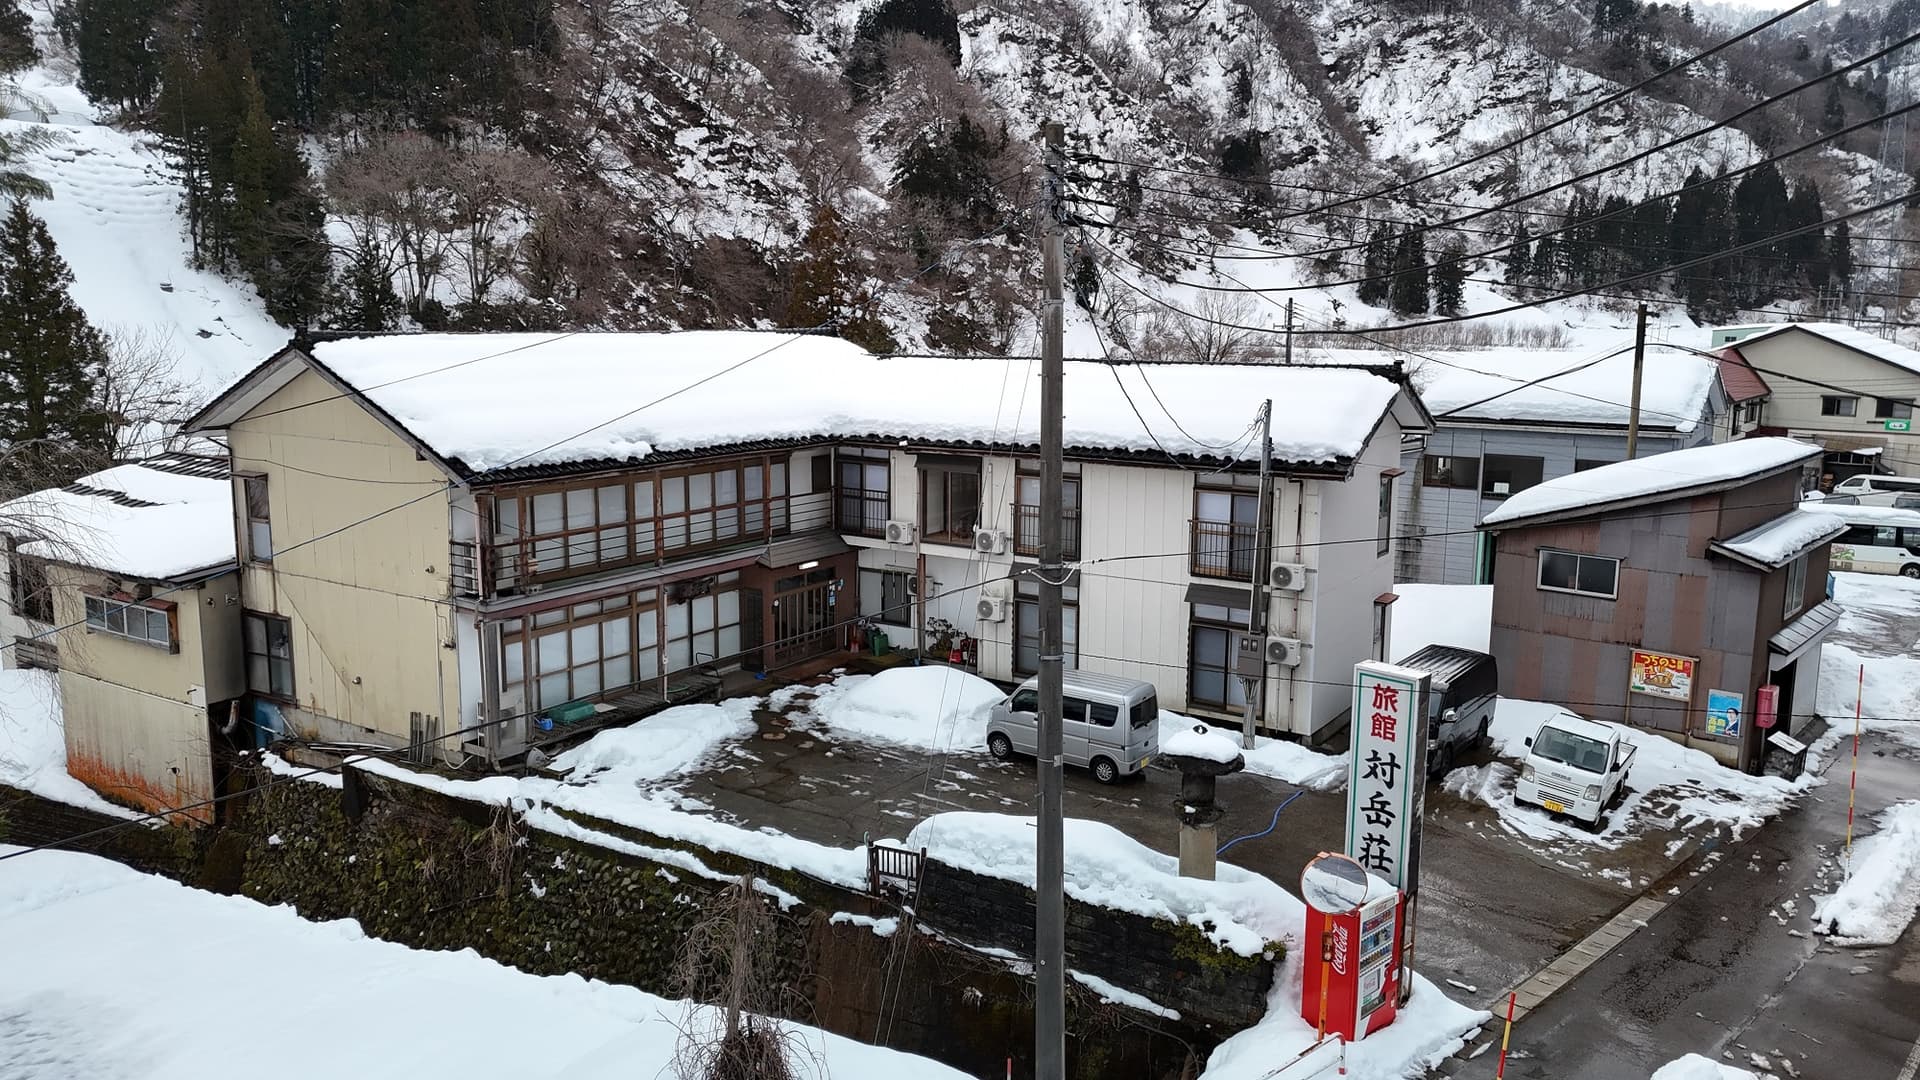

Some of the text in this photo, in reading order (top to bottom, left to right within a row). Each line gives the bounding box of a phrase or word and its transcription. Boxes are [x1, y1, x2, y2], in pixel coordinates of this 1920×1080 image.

[1370, 683, 1399, 742] 旅館
[1358, 750, 1401, 873] 対岳荘
